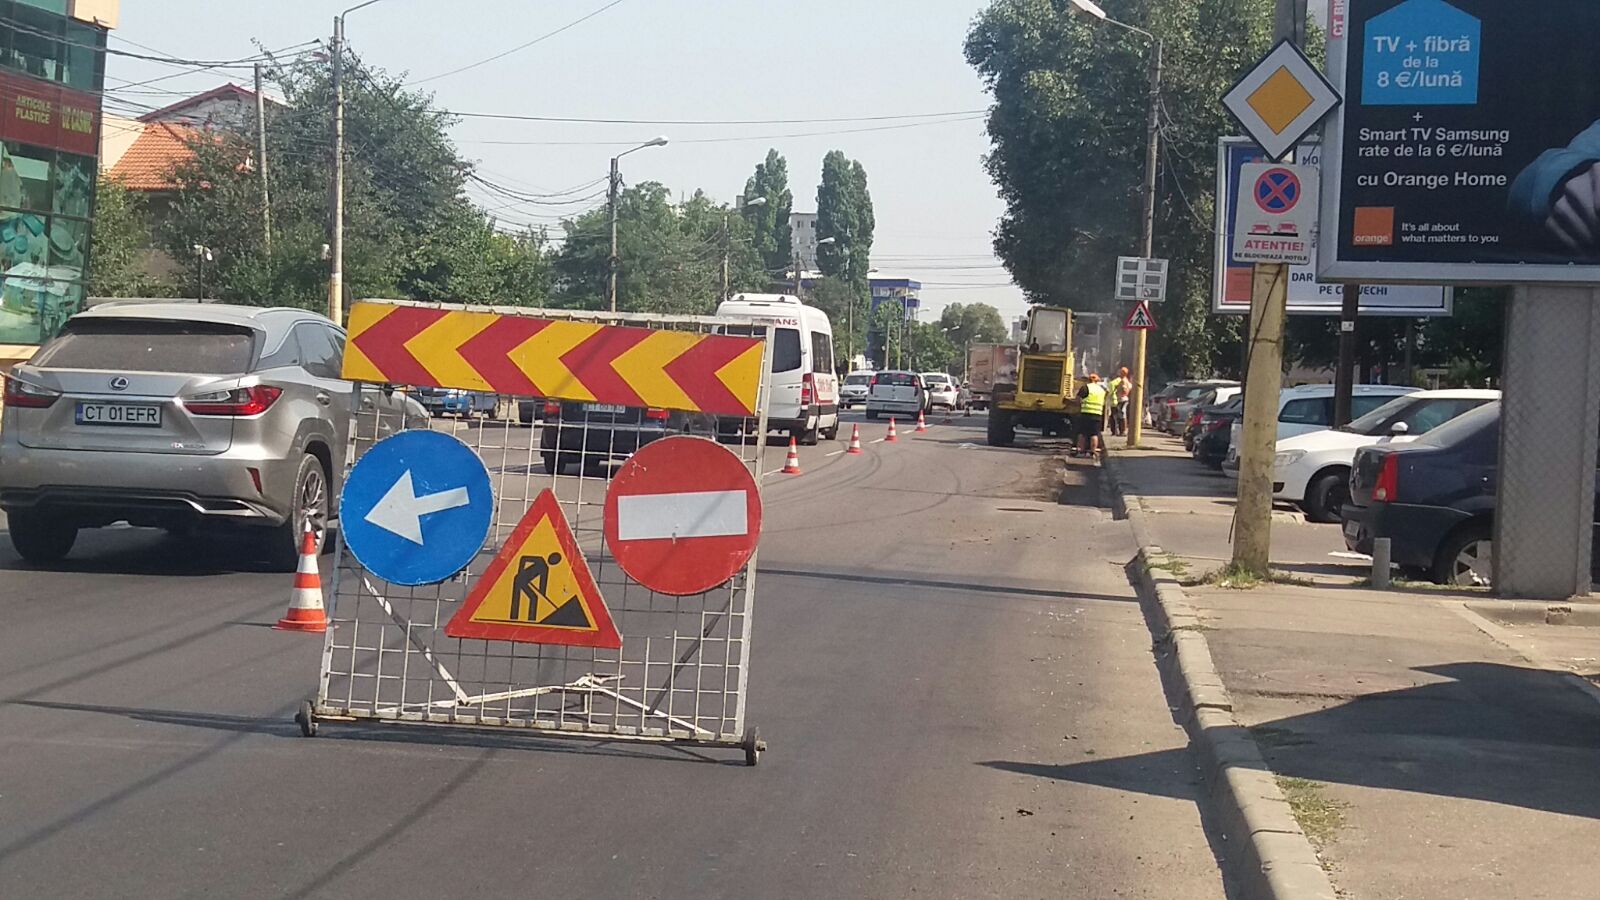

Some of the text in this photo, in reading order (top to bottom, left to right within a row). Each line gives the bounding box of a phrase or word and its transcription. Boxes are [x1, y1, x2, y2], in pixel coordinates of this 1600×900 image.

[1373, 36, 1400, 52] TV
[1424, 35, 1470, 52] fibră
[1402, 56, 1439, 68] de la
[1377, 70, 1462, 88] 8 €/lună
[16, 107, 51, 124] PLASTICE
[1359, 127, 1510, 143] Smart TV Samsung
[1358, 143, 1503, 157] rate de la 6 €/lună
[1357, 171, 1507, 189] cu Orange Home
[1401, 222, 1460, 232] It's all about
[1355, 235, 1389, 244] orange
[1401, 234, 1499, 245] what matters to you
[1291, 272, 1314, 282] DAR
[1319, 285, 1333, 295] PE
[85, 406, 104, 420] CT
